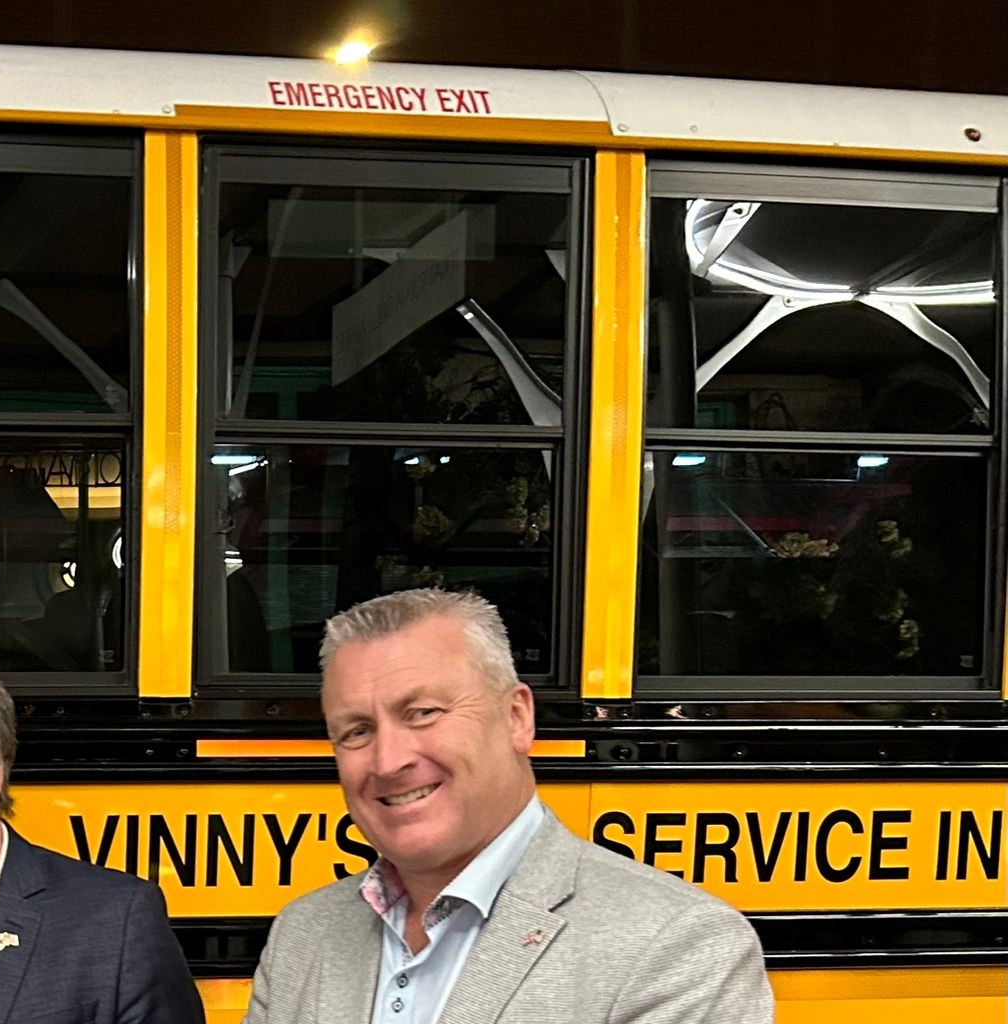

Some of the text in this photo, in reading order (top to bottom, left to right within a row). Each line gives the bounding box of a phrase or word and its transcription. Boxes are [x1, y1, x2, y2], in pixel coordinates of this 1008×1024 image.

[268, 81, 492, 114] EMERGENCY EXIT
[69, 813, 380, 887] VINNY'S
[592, 809, 913, 883] SERVICE
